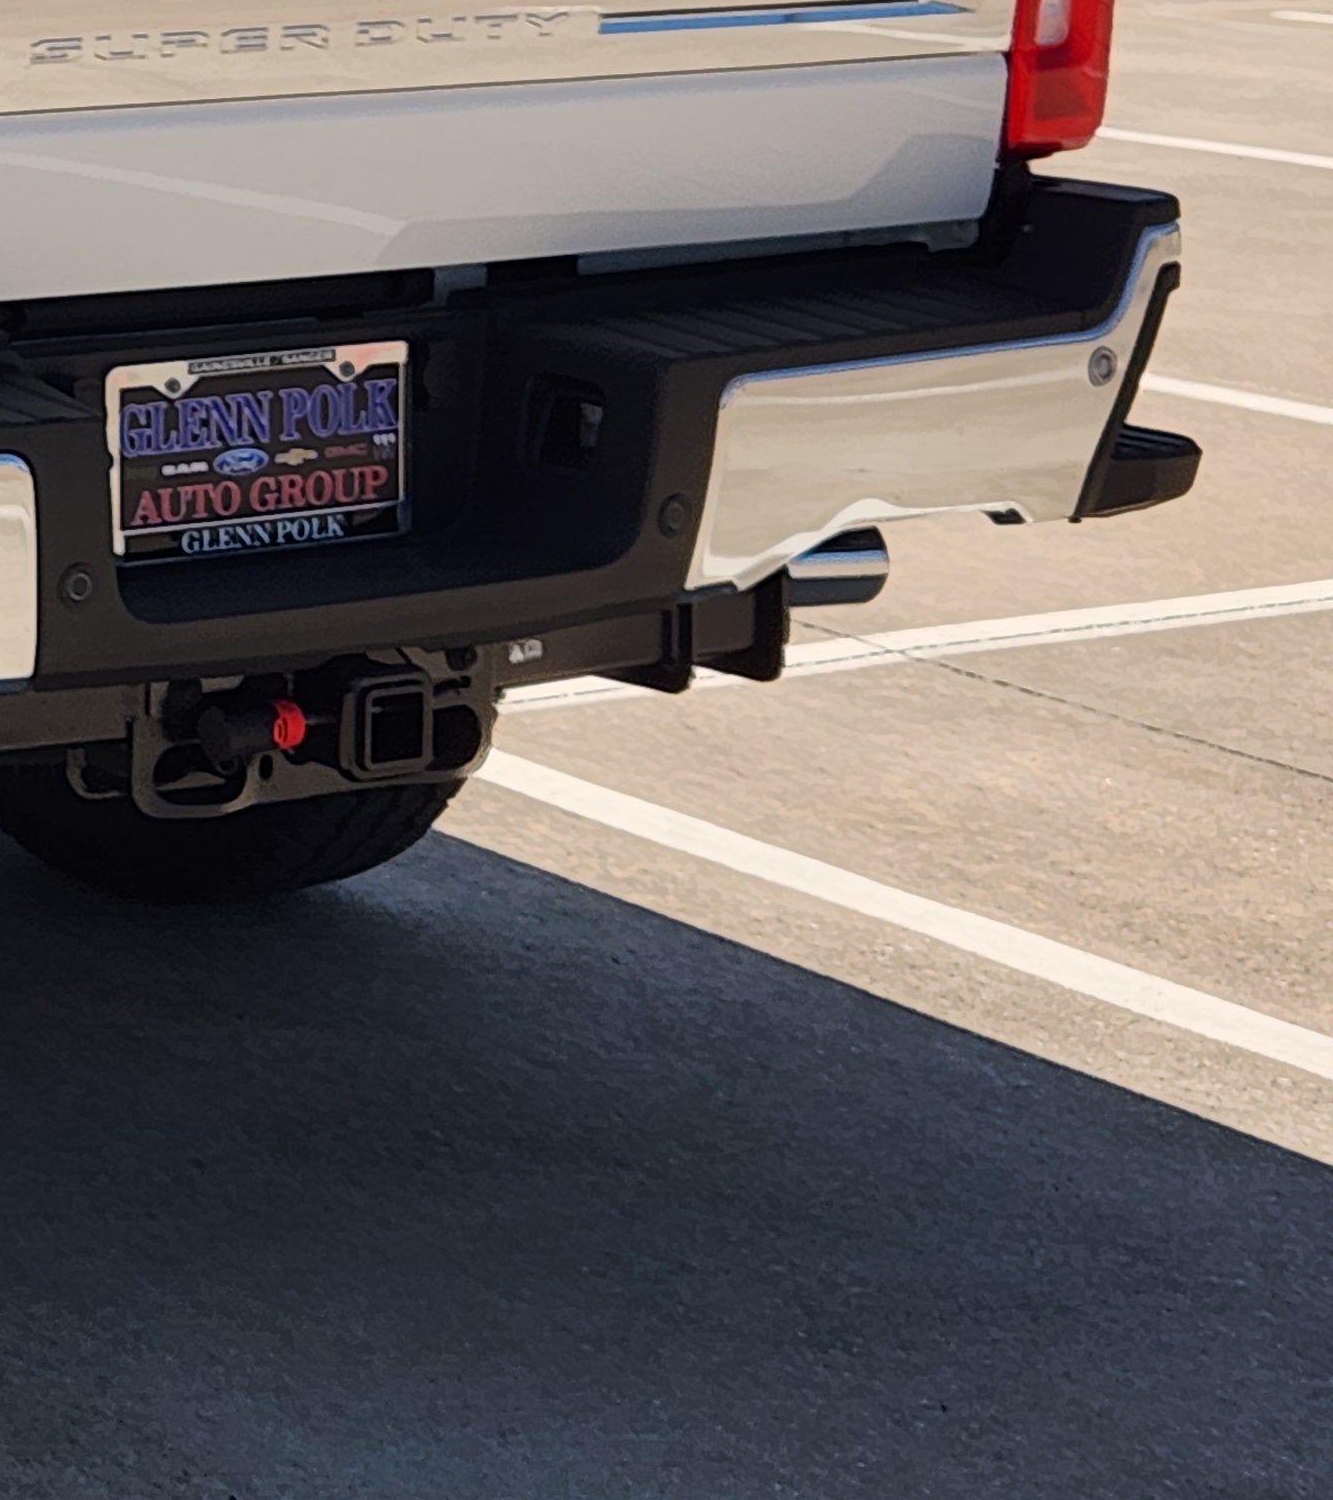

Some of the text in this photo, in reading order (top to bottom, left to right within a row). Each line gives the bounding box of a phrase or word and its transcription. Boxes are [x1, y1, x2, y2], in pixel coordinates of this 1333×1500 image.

[31, 11, 569, 64] SUPER DUTY
[120, 378, 399, 458] GLENN POLK
[130, 465, 388, 526] AUTO GROUP
[181, 514, 345, 554] GLENN POLK
